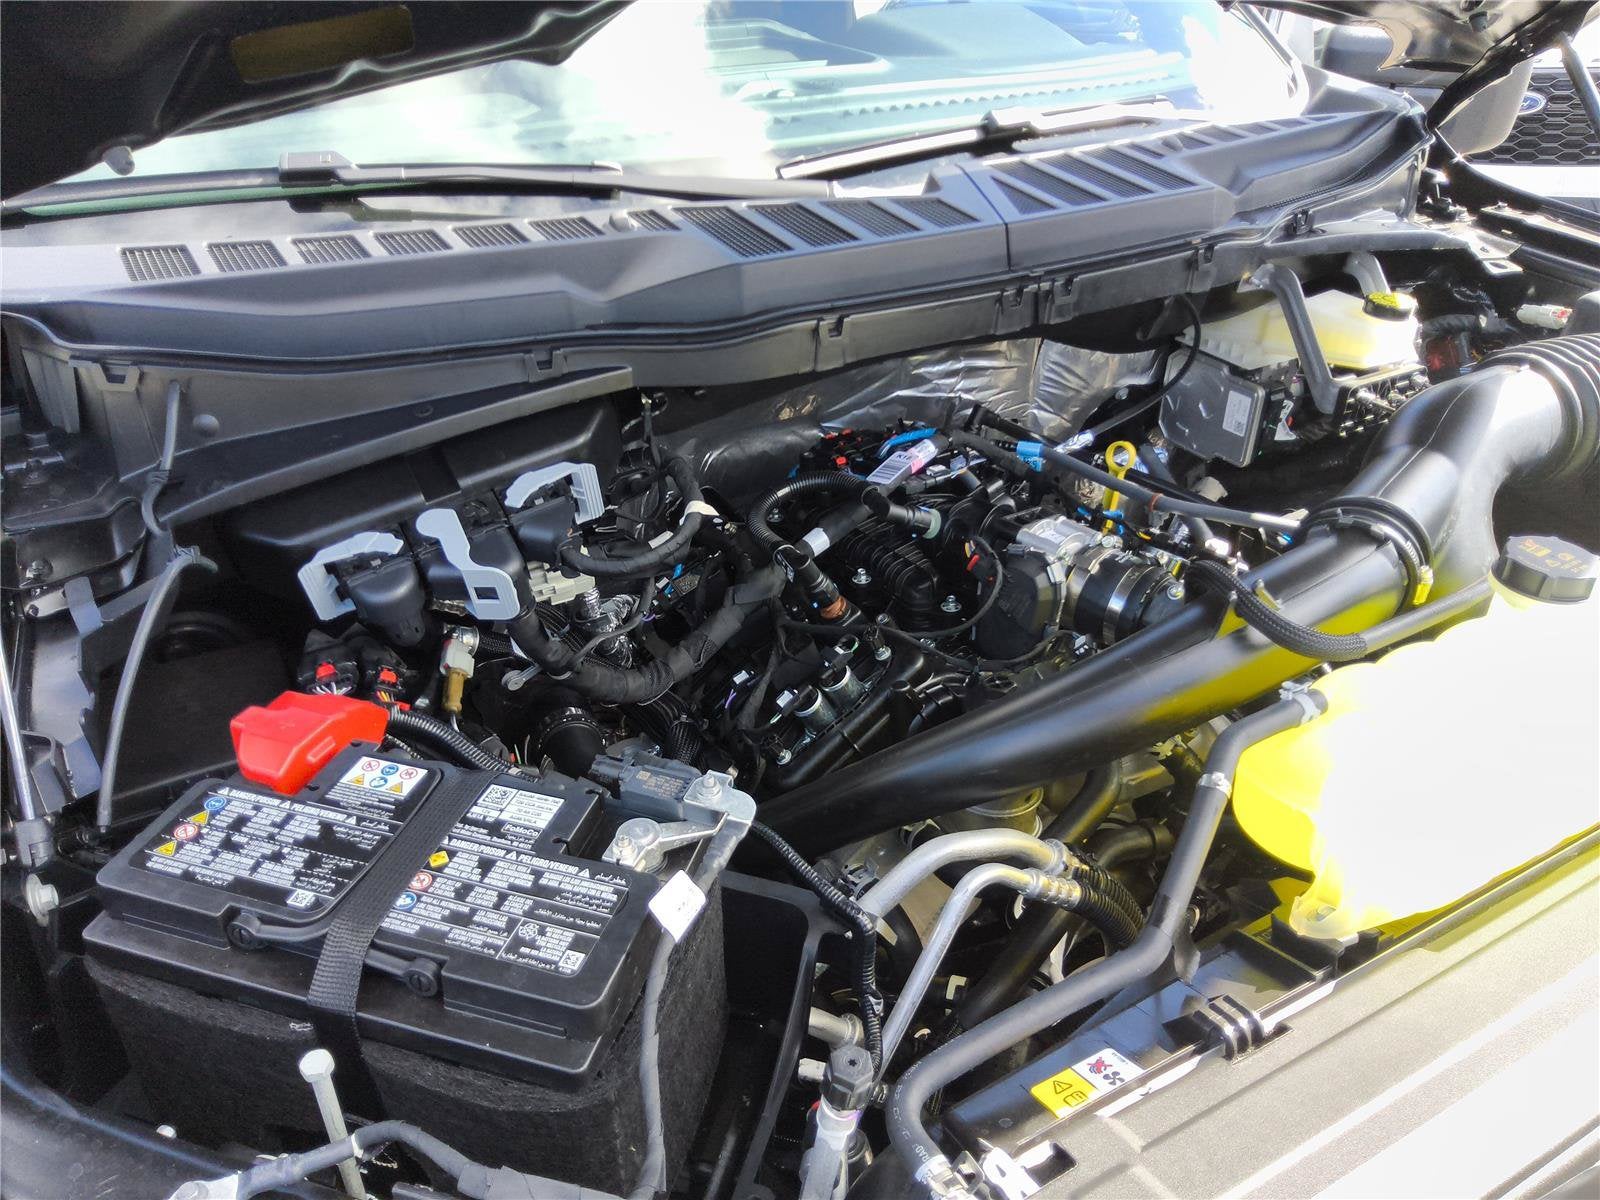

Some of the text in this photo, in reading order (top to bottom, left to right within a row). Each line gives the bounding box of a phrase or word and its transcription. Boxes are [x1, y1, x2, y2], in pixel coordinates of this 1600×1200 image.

[505, 824, 539, 837] FoMoCo
[449, 839, 506, 857] DANGER/POISON
[517, 854, 580, 874] PELIGRO/VENENO
